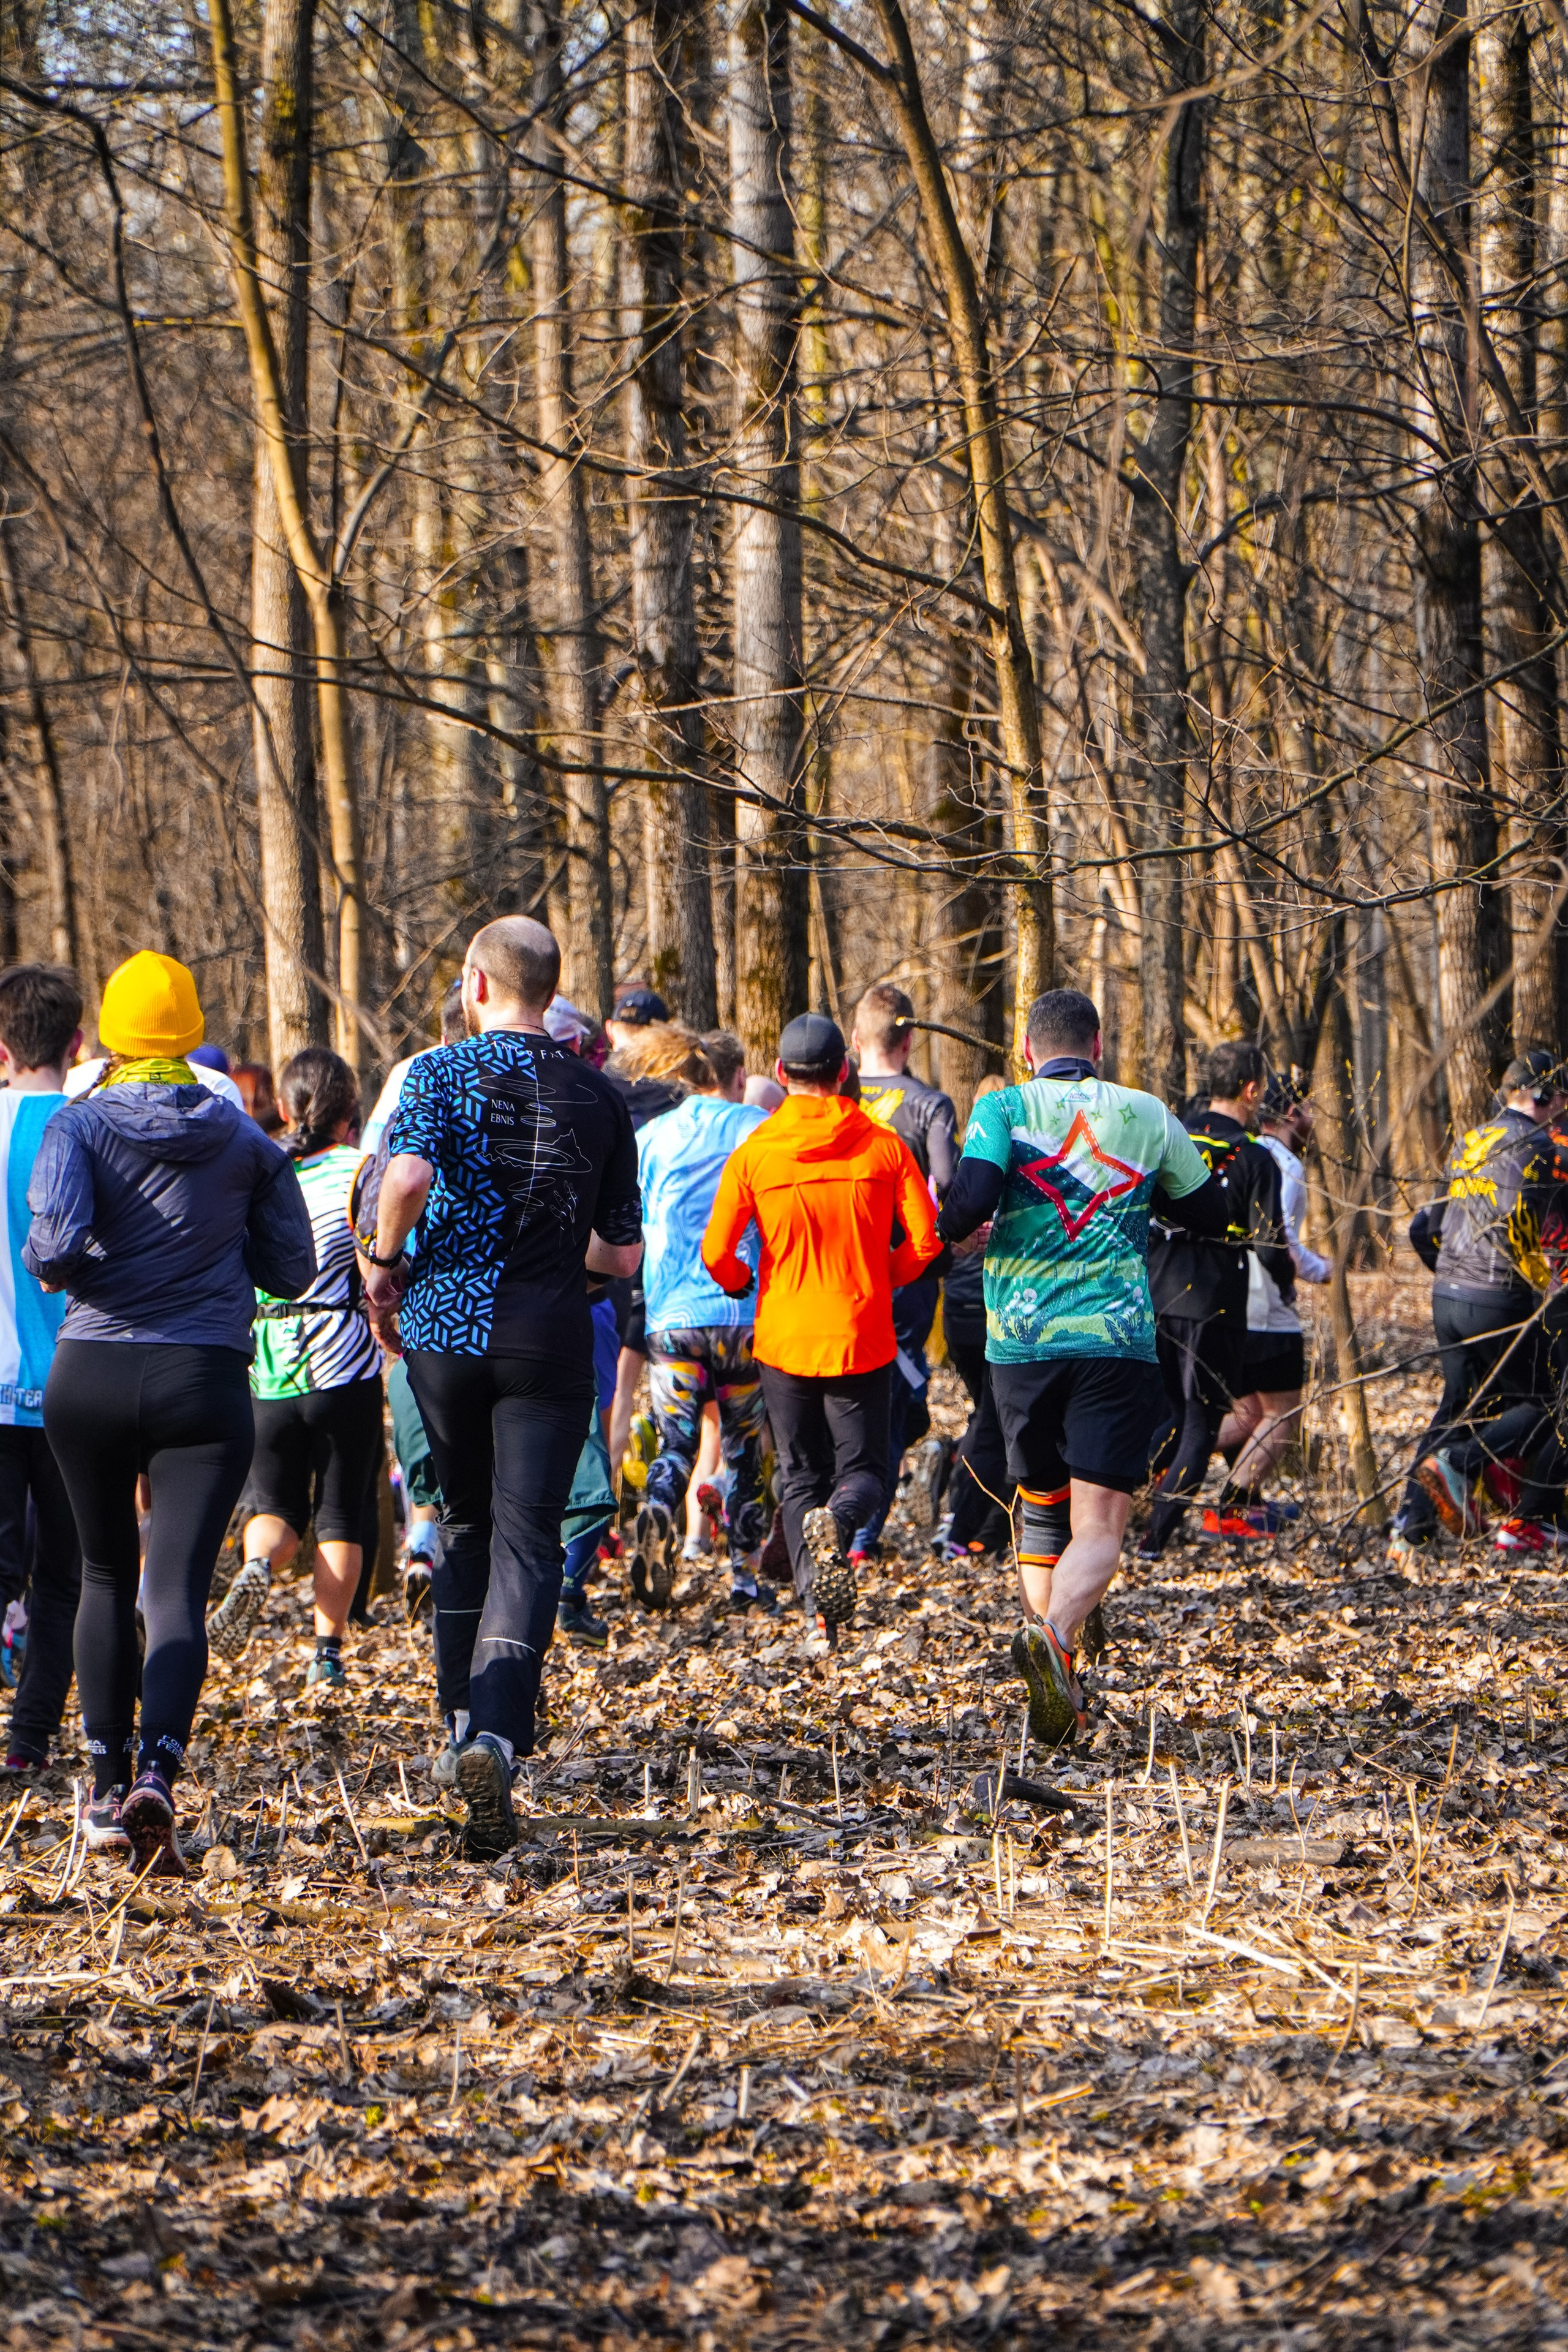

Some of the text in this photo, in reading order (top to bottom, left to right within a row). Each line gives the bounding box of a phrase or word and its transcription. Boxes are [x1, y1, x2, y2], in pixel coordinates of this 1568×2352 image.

[491, 1099, 515, 1112] NENA
[491, 1113, 514, 1126] EBNIS
[15, 1387, 43, 1408] TEA
